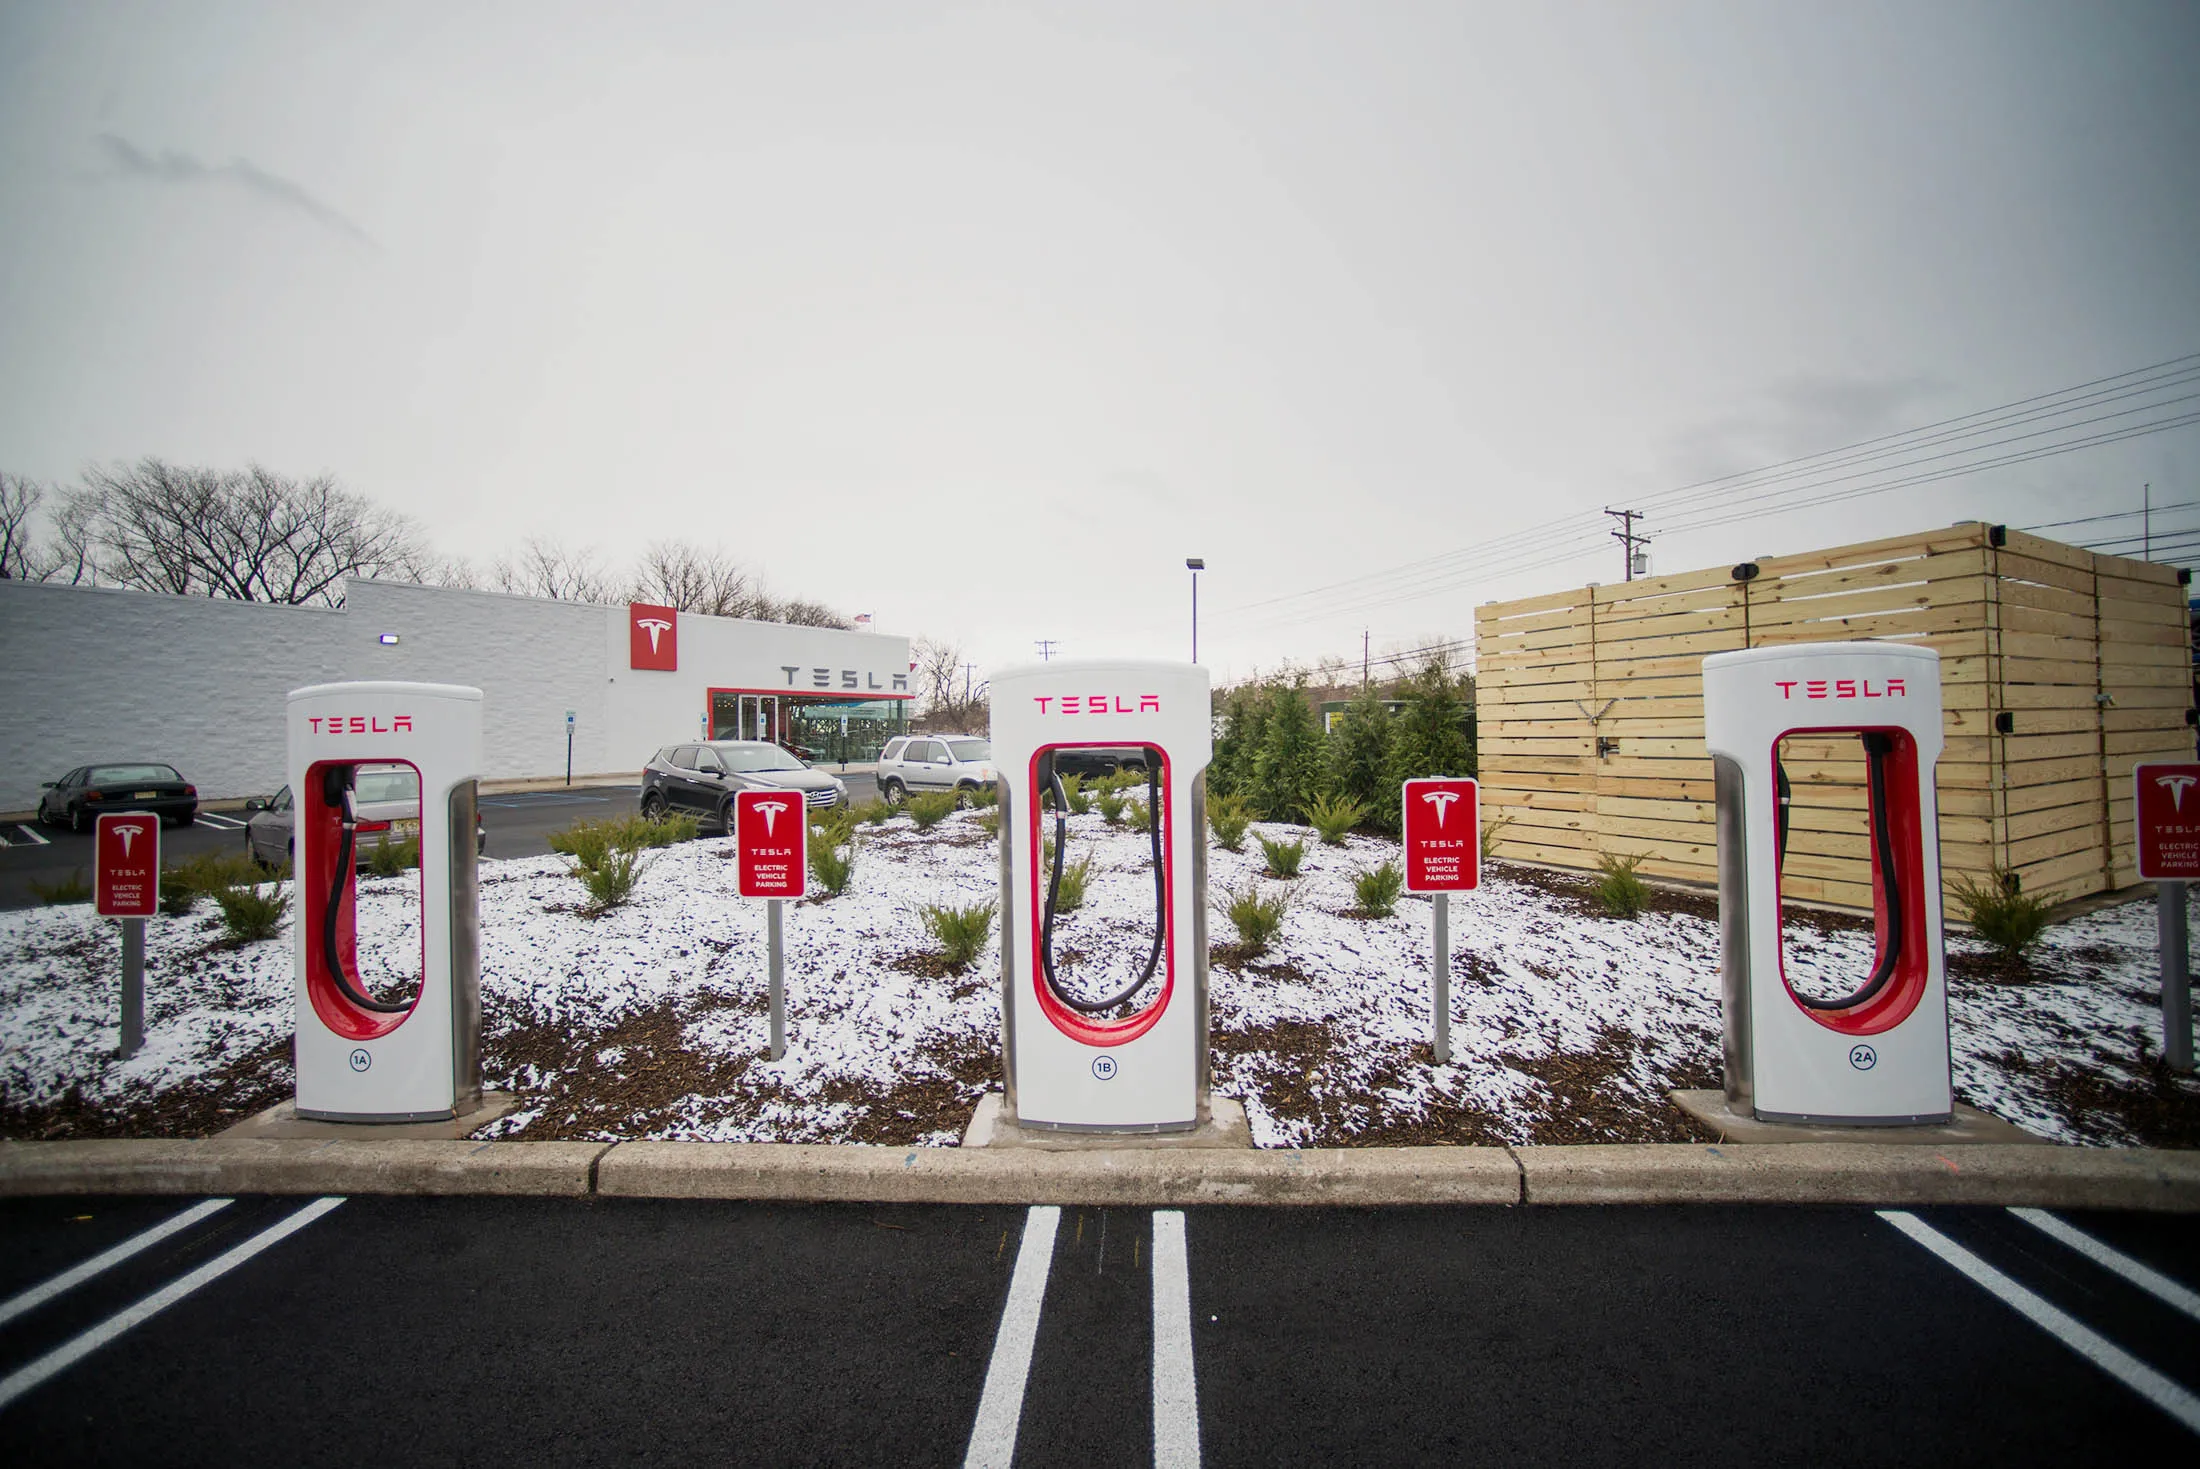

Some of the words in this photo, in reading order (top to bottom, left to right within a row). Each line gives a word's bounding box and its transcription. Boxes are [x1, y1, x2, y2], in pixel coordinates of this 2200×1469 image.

[780, 666, 907, 690] TESLA
[1774, 679, 1906, 700] TESLA
[1033, 695, 1159, 715] TESLA
[308, 716, 412, 734] TESLA
[1420, 840, 1464, 848] TESLA
[2159, 842, 2199, 850] ELECTRIC
[751, 848, 792, 856] TESLA
[2161, 851, 2198, 859] VEHICLE
[2160, 860, 2199, 868] PARKING
[110, 869, 146, 877] TESLA
[354, 1055, 367, 1065] 1A
[1854, 1051, 1873, 1062] 2A
[1097, 1062, 1112, 1073] 1B
